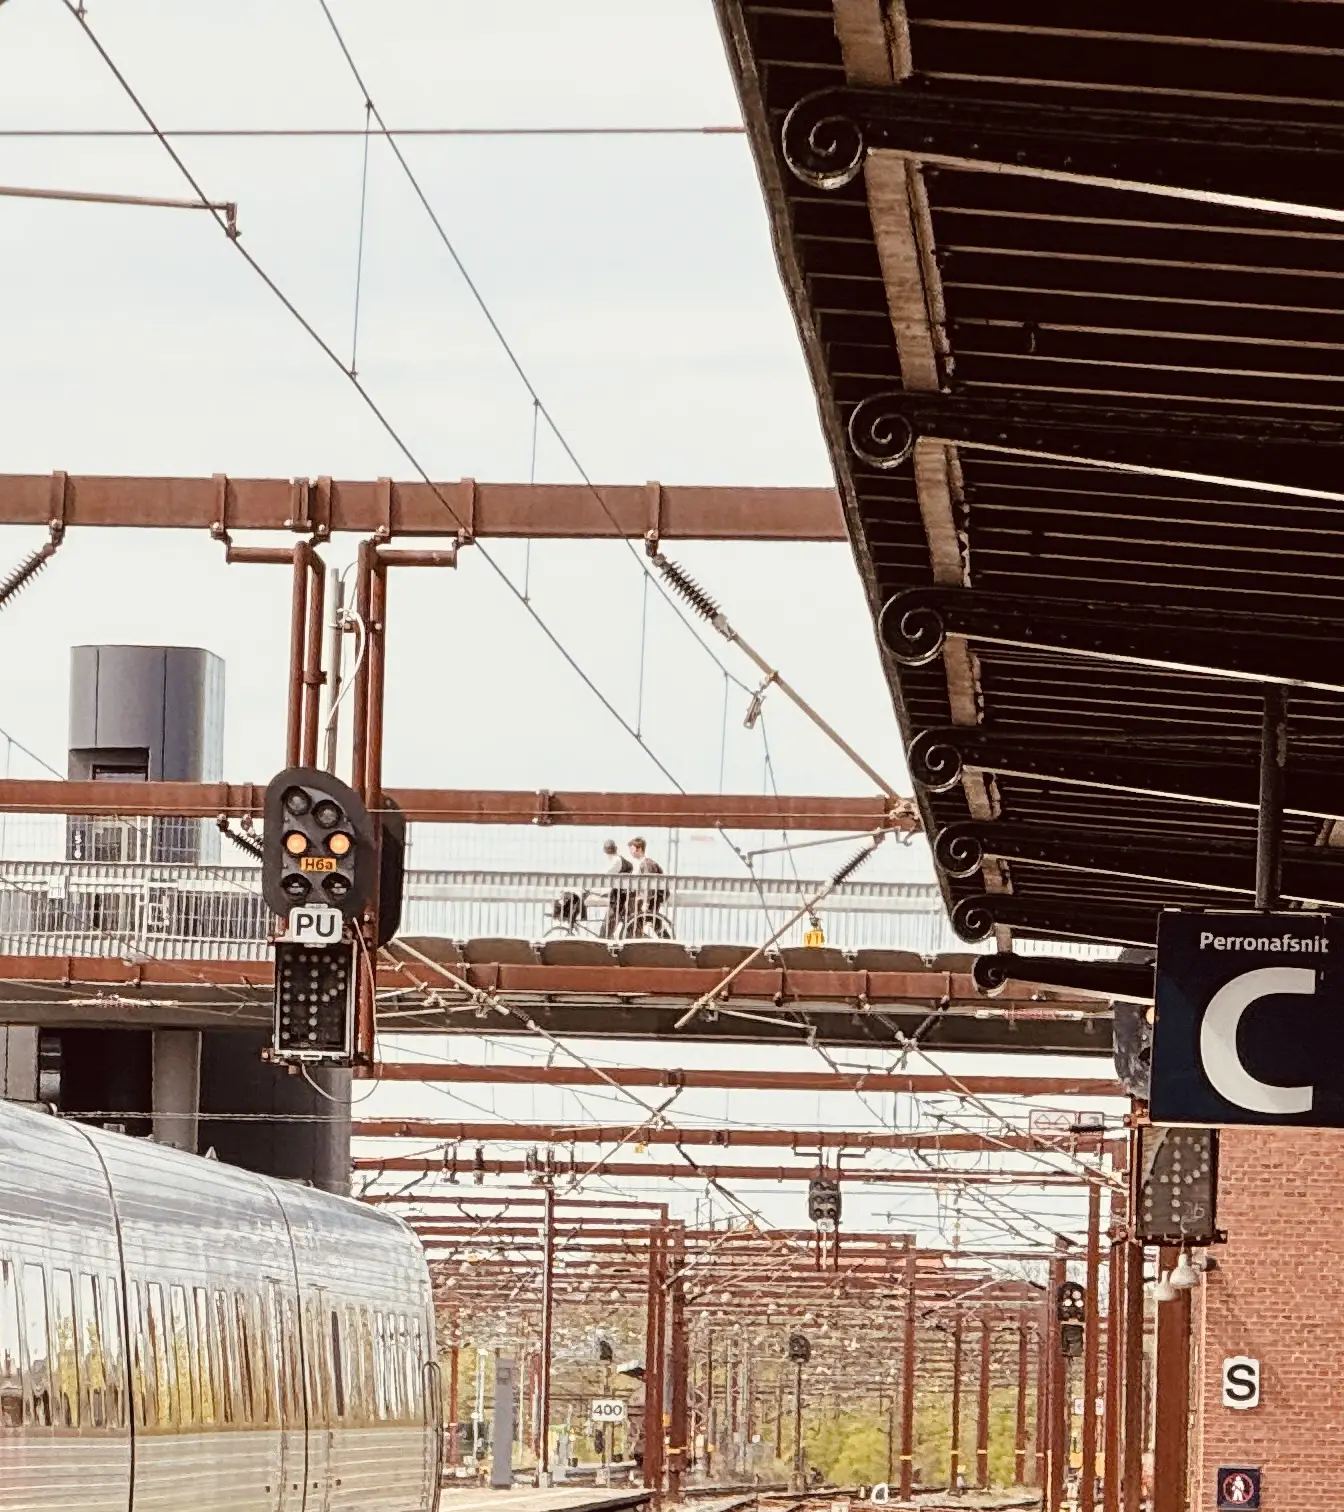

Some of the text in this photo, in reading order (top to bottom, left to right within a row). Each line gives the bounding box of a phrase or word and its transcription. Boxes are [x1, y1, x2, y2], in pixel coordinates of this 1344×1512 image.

[296, 913, 335, 937] PU
[1200, 931, 1330, 953] Perronafsnit
[1200, 966, 1316, 1115] C
[1225, 1363, 1257, 1402] S
[593, 1404, 622, 1416] 400
